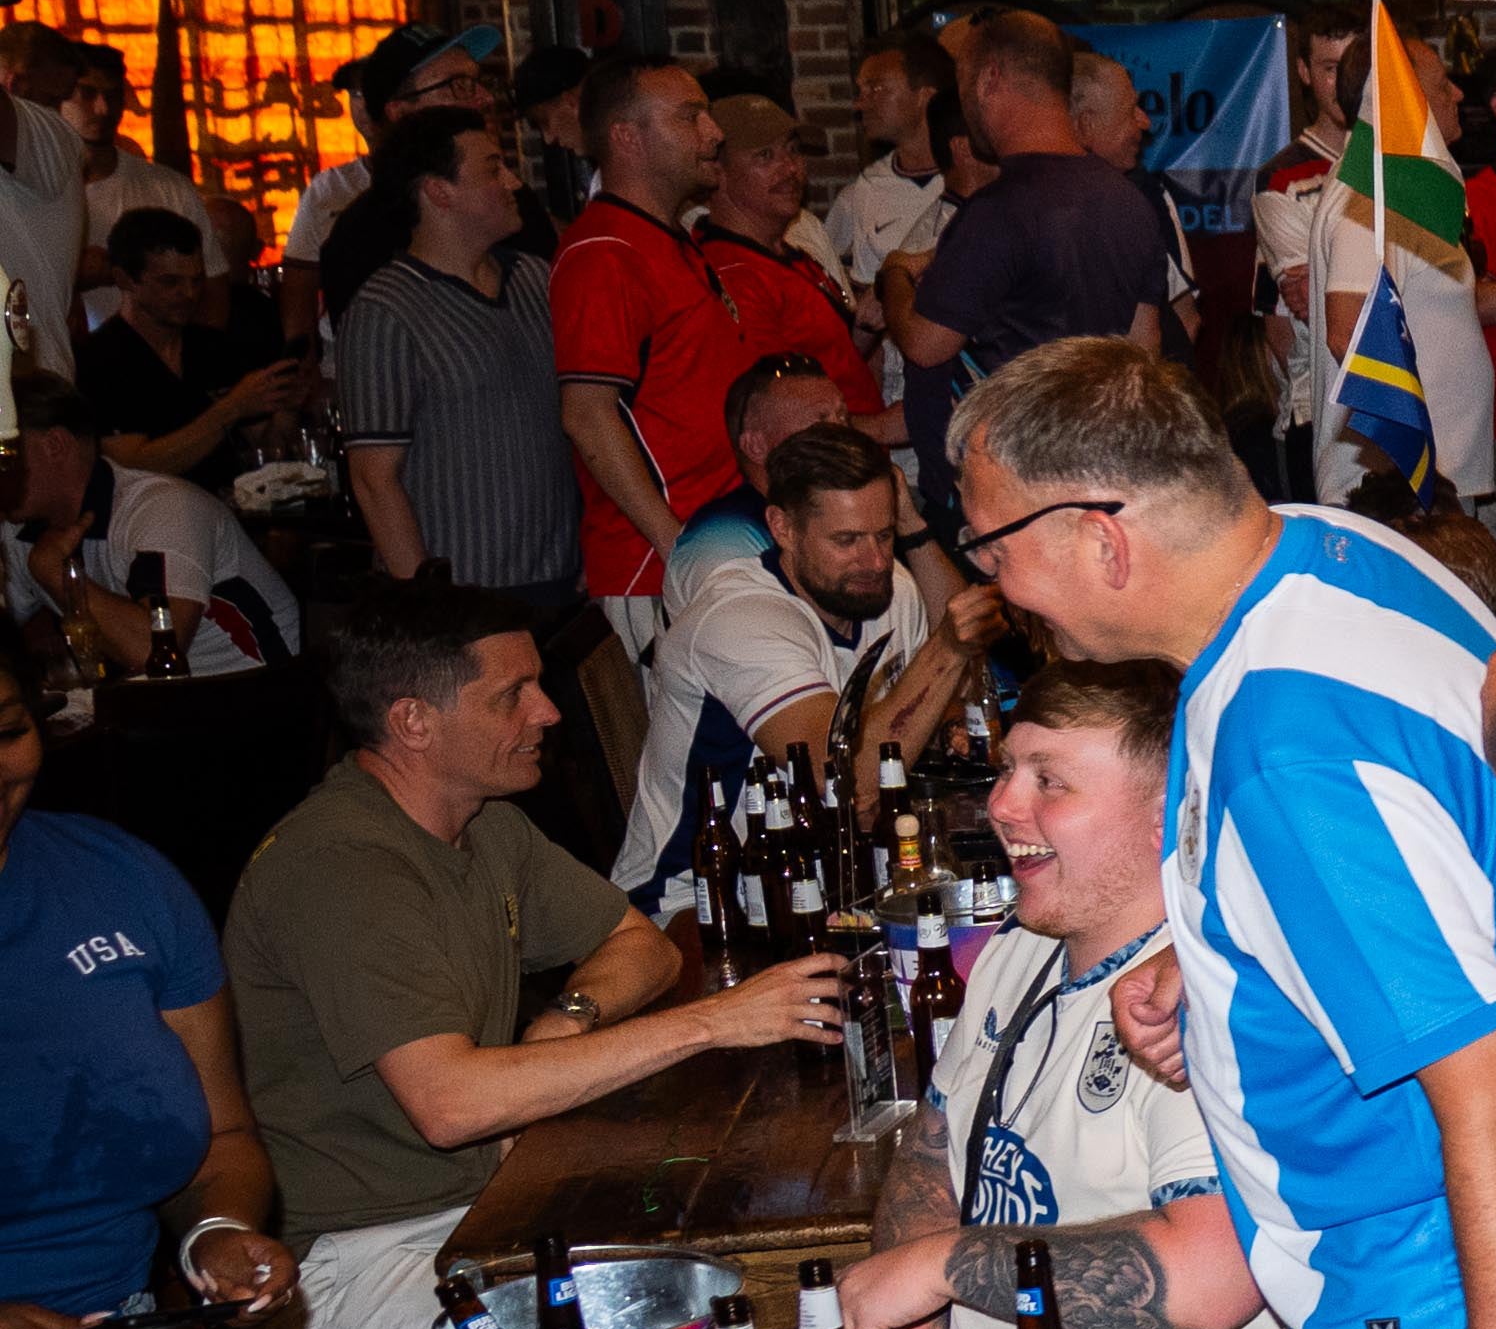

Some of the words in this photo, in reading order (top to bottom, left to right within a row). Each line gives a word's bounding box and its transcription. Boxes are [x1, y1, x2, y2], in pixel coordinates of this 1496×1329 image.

[1138, 73, 1217, 137] elo
[66, 929, 147, 977] USA
[982, 1136, 1024, 1187] HEY
